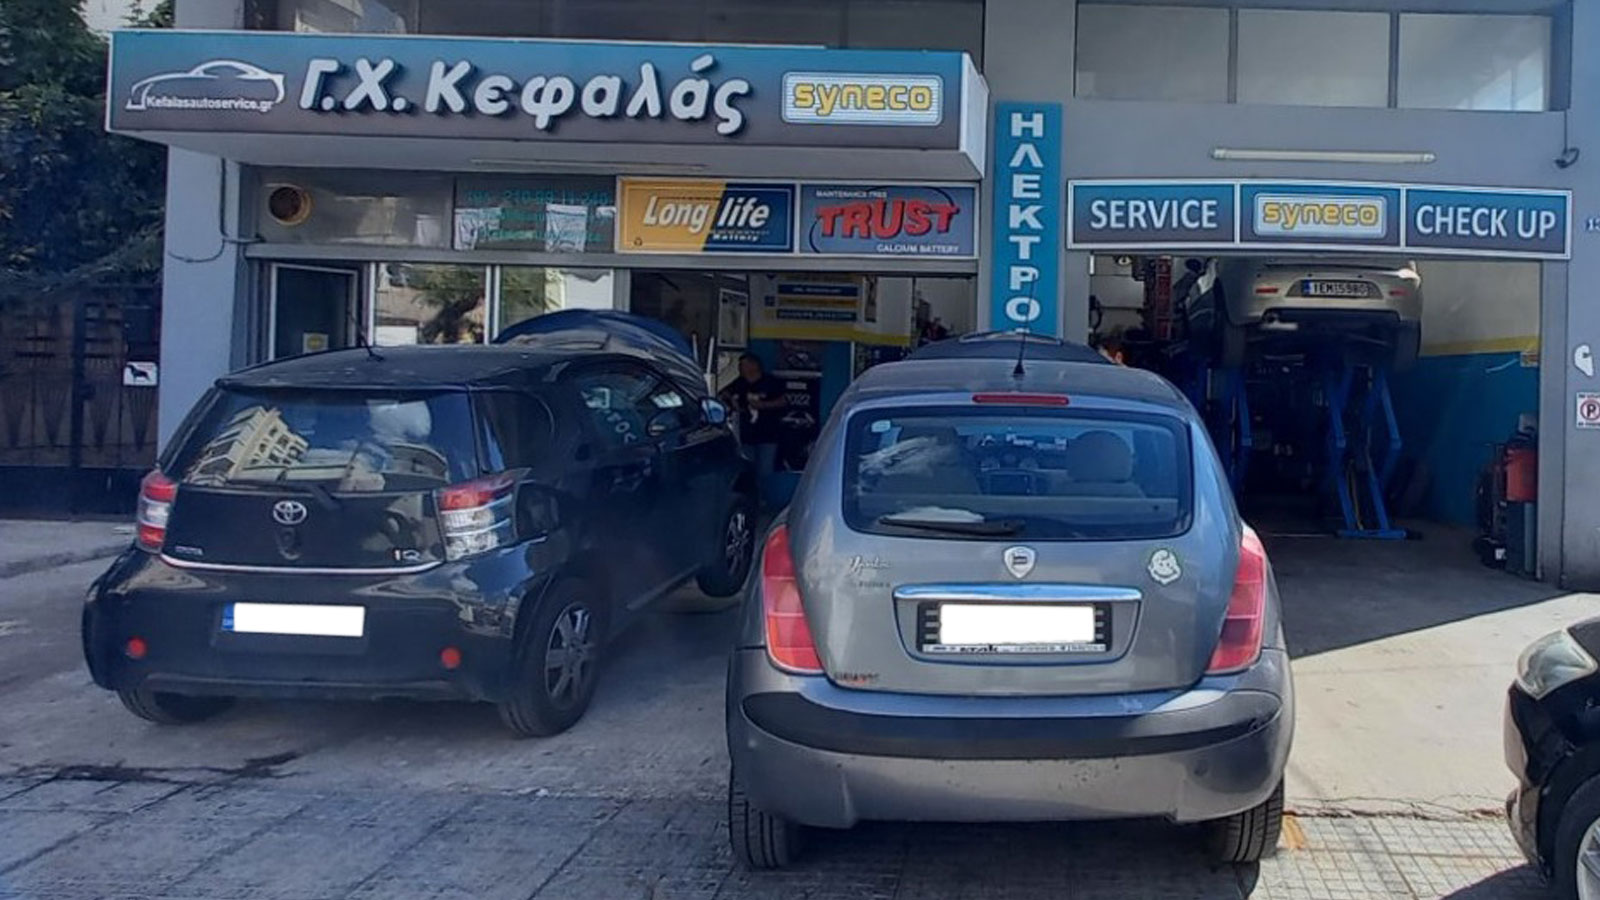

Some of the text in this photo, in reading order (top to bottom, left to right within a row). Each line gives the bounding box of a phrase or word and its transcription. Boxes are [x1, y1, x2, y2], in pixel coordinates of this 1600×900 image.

[424, 53, 750, 136] Κεφαλάς
[793, 82, 935, 117] syneco
[643, 195, 710, 234] Long
[717, 197, 770, 228] life
[815, 197, 961, 240] TRUST
[1005, 112, 1044, 333] ΗΛΕΚΤΡΟ
[1090, 199, 1218, 230] SERVICE
[1263, 202, 1379, 230] syneco
[1416, 205, 1556, 239] CHECK UP
[876, 243, 960, 254] CALCIUM BATTERY
